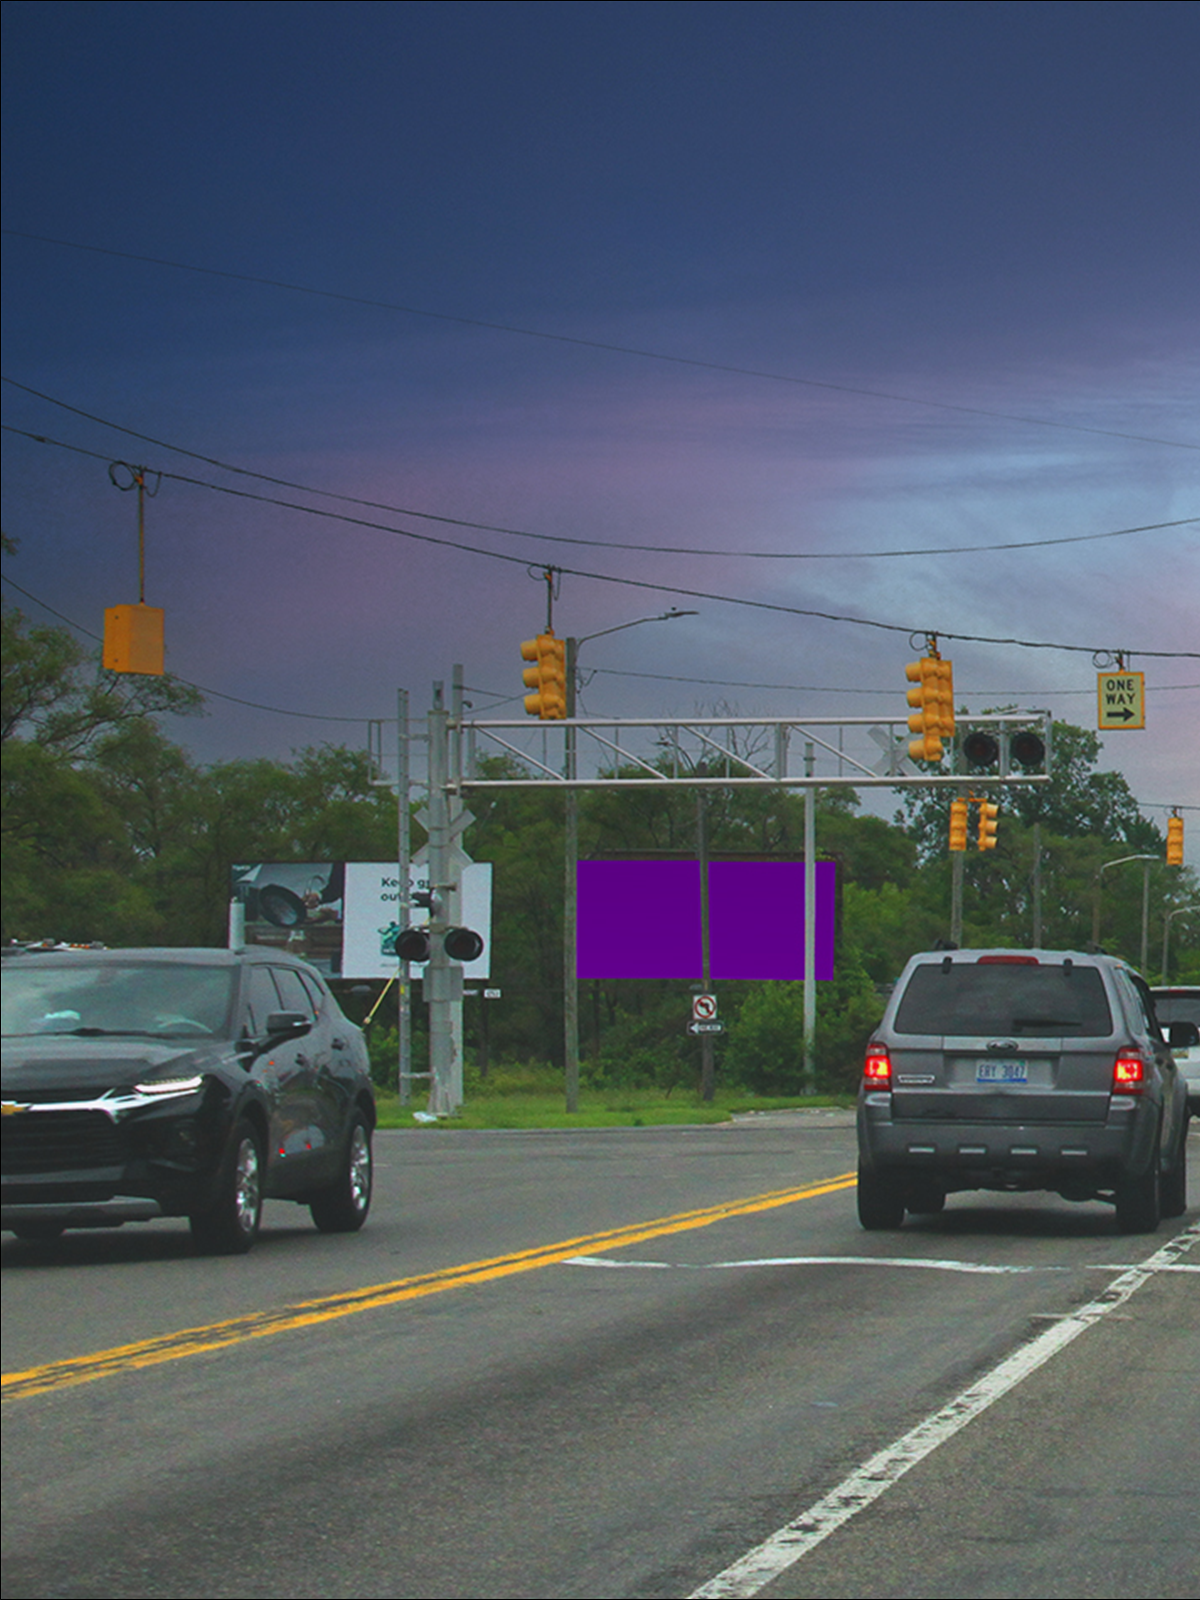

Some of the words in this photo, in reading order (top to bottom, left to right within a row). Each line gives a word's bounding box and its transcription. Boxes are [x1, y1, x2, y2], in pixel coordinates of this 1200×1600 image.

[1106, 679, 1135, 691] ONE
[1105, 693, 1136, 705] WAY
[381, 877, 414, 890] Ke
[380, 893, 403, 902] ou
